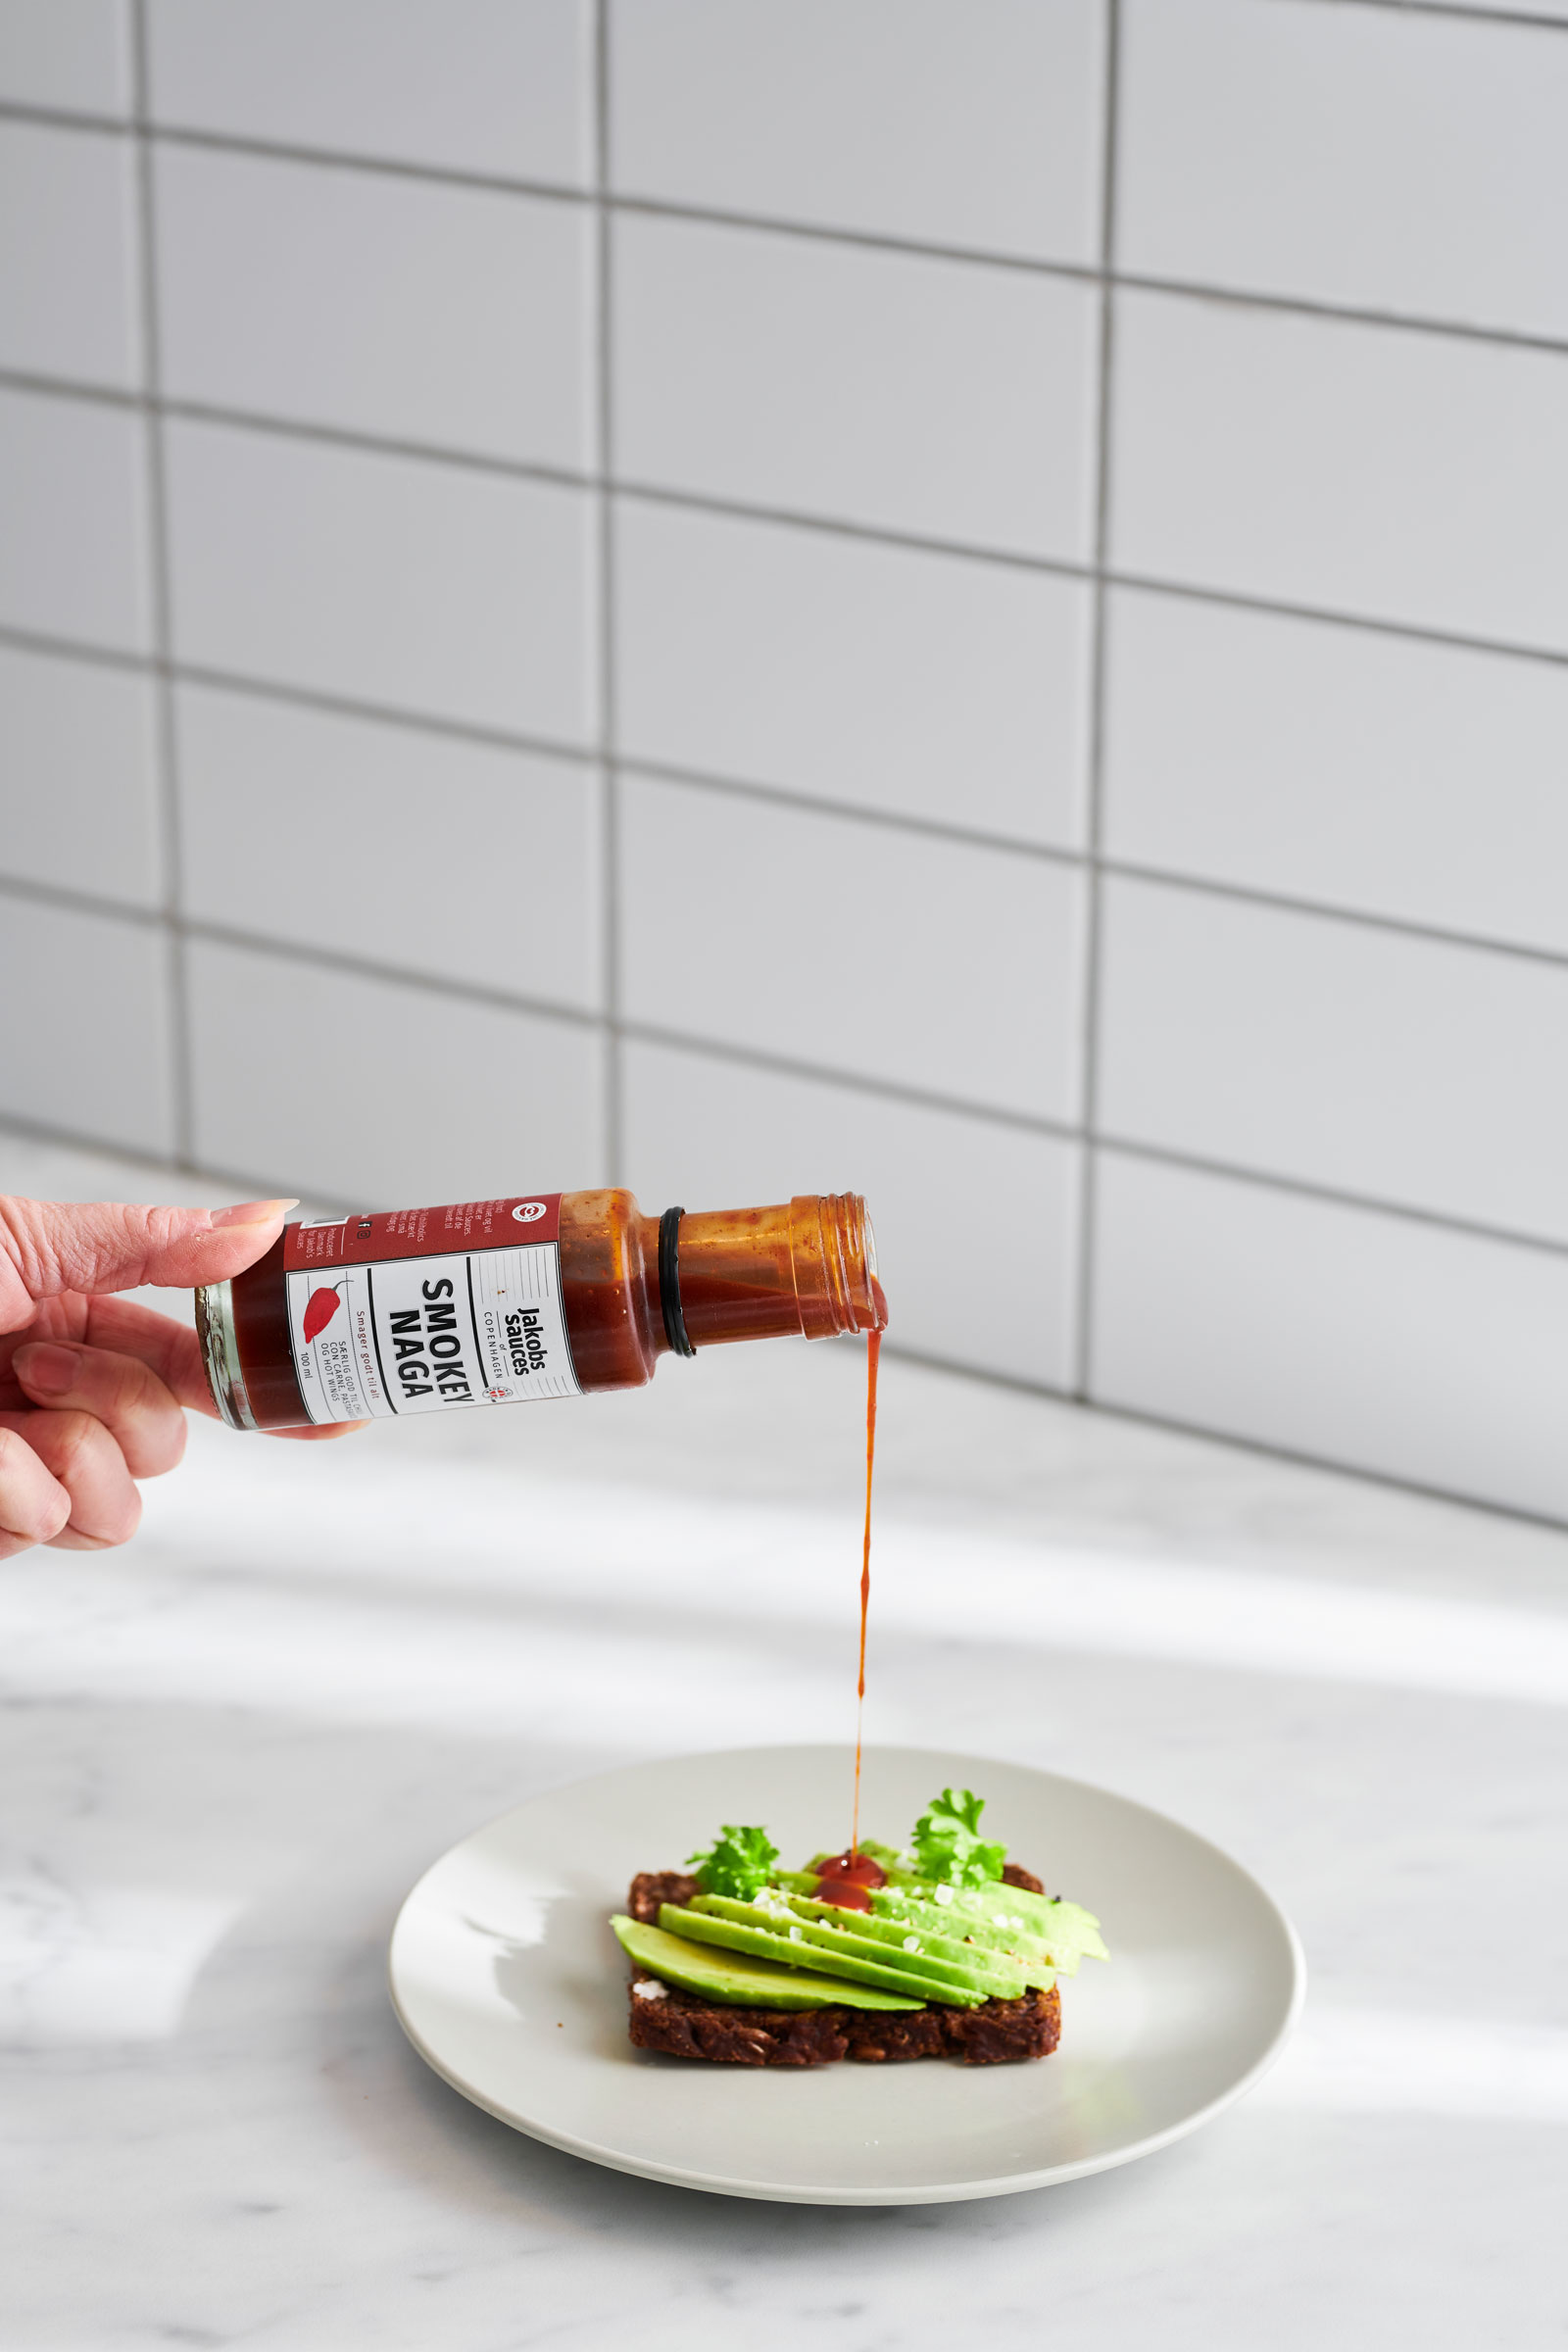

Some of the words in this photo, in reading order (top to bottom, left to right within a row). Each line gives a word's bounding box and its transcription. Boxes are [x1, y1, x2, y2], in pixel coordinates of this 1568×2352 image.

[296, 1231, 307, 1250] Sauces
[306, 1237, 316, 1259] Jakob's
[316, 1231, 326, 1256] Danmark
[326, 1227, 337, 1257] Produceret
[357, 1310, 368, 1349] Smager
[422, 1278, 475, 1402] SMOKEY
[517, 1307, 548, 1370] Jakobs
[320, 1343, 330, 1356] OG
[329, 1342, 339, 1360] CON
[390, 1309, 434, 1399] NAGA
[484, 1311, 503, 1379] COPENHAGEN
[505, 1314, 529, 1376] sauces
[301, 1351, 311, 1367] 100
[323, 1359, 333, 1376] HOT
[361, 1353, 373, 1374] godt
[304, 1368, 313, 1379] ml
[333, 1363, 346, 1392] CARNE,
[338, 1341, 352, 1374] SÆRLIG
[345, 1373, 355, 1392] GOD
[350, 1394, 359, 1402] TIL
[368, 1377, 377, 1387] til
[327, 1379, 340, 1401] WINGS
[370, 1389, 380, 1398] alt
